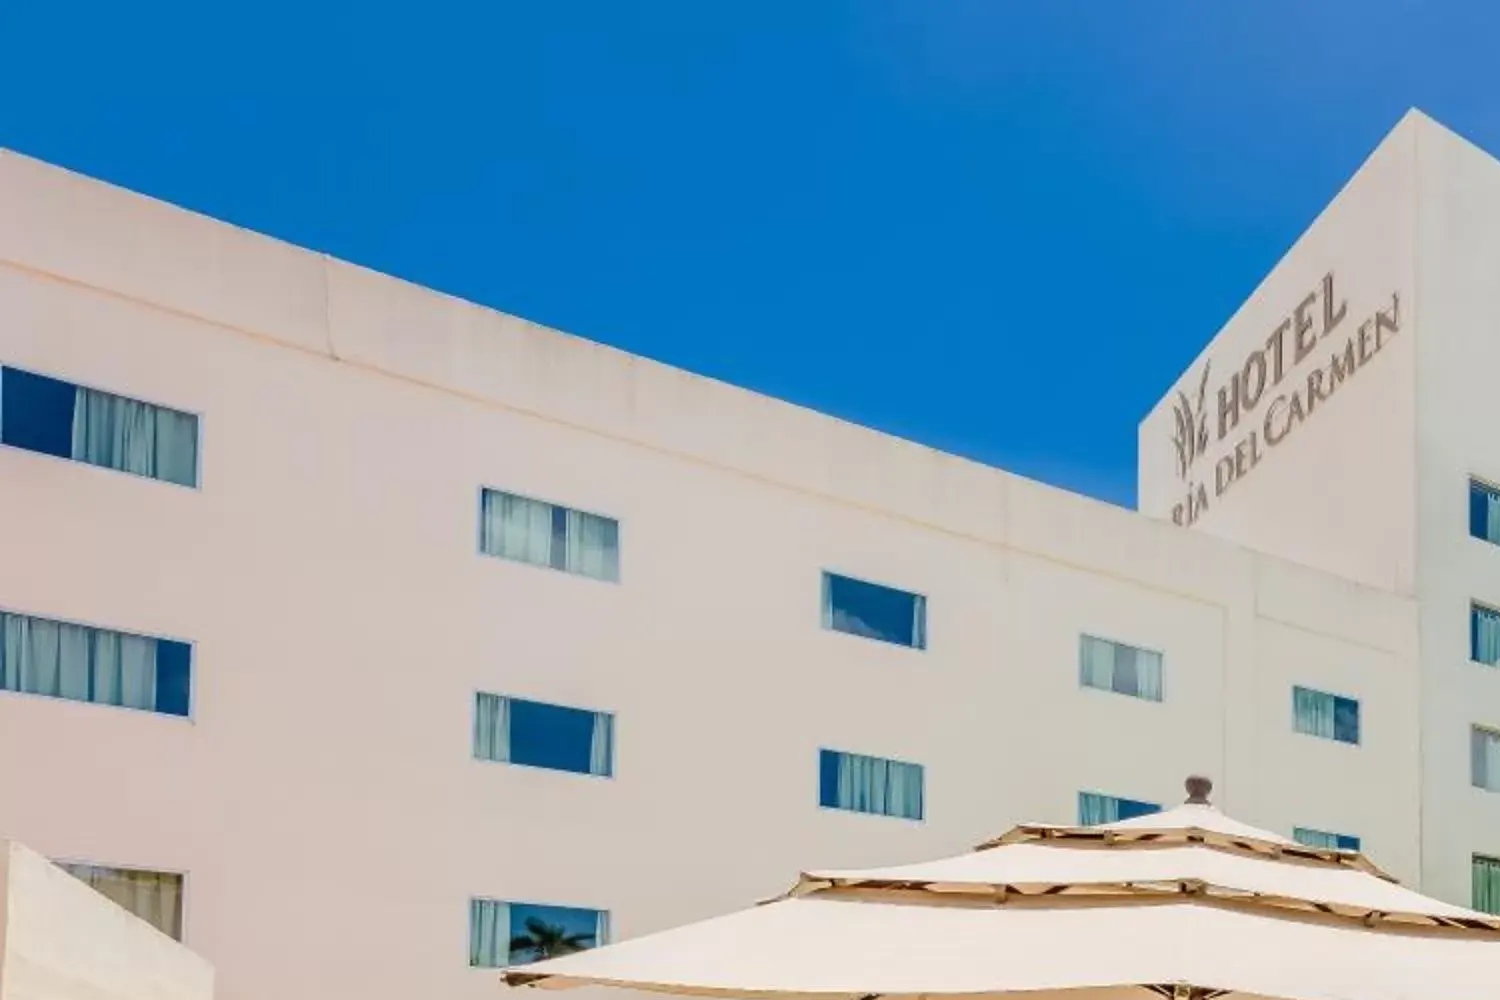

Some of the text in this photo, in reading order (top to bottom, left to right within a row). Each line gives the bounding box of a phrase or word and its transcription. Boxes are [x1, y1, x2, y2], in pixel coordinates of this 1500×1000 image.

[1215, 431, 1262, 498] DEL
[1263, 290, 1400, 447] CARMEN
[1217, 270, 1348, 441] HOTEL
